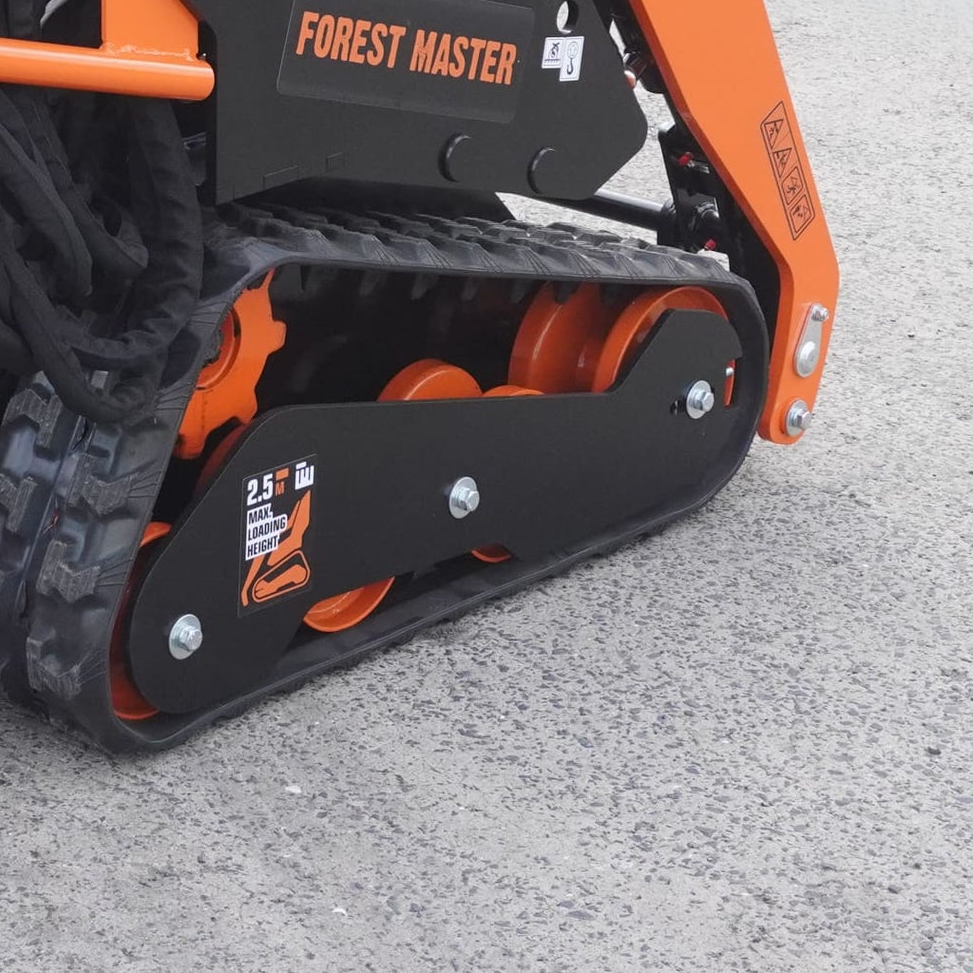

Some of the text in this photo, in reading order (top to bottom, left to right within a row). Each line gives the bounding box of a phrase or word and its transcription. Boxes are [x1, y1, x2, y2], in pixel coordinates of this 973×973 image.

[295, 10, 517, 85] FOREST MASTER
[246, 473, 285, 506] 2.5 M
[248, 516, 286, 541] LOADING
[247, 535, 278, 558] HEIGHT
